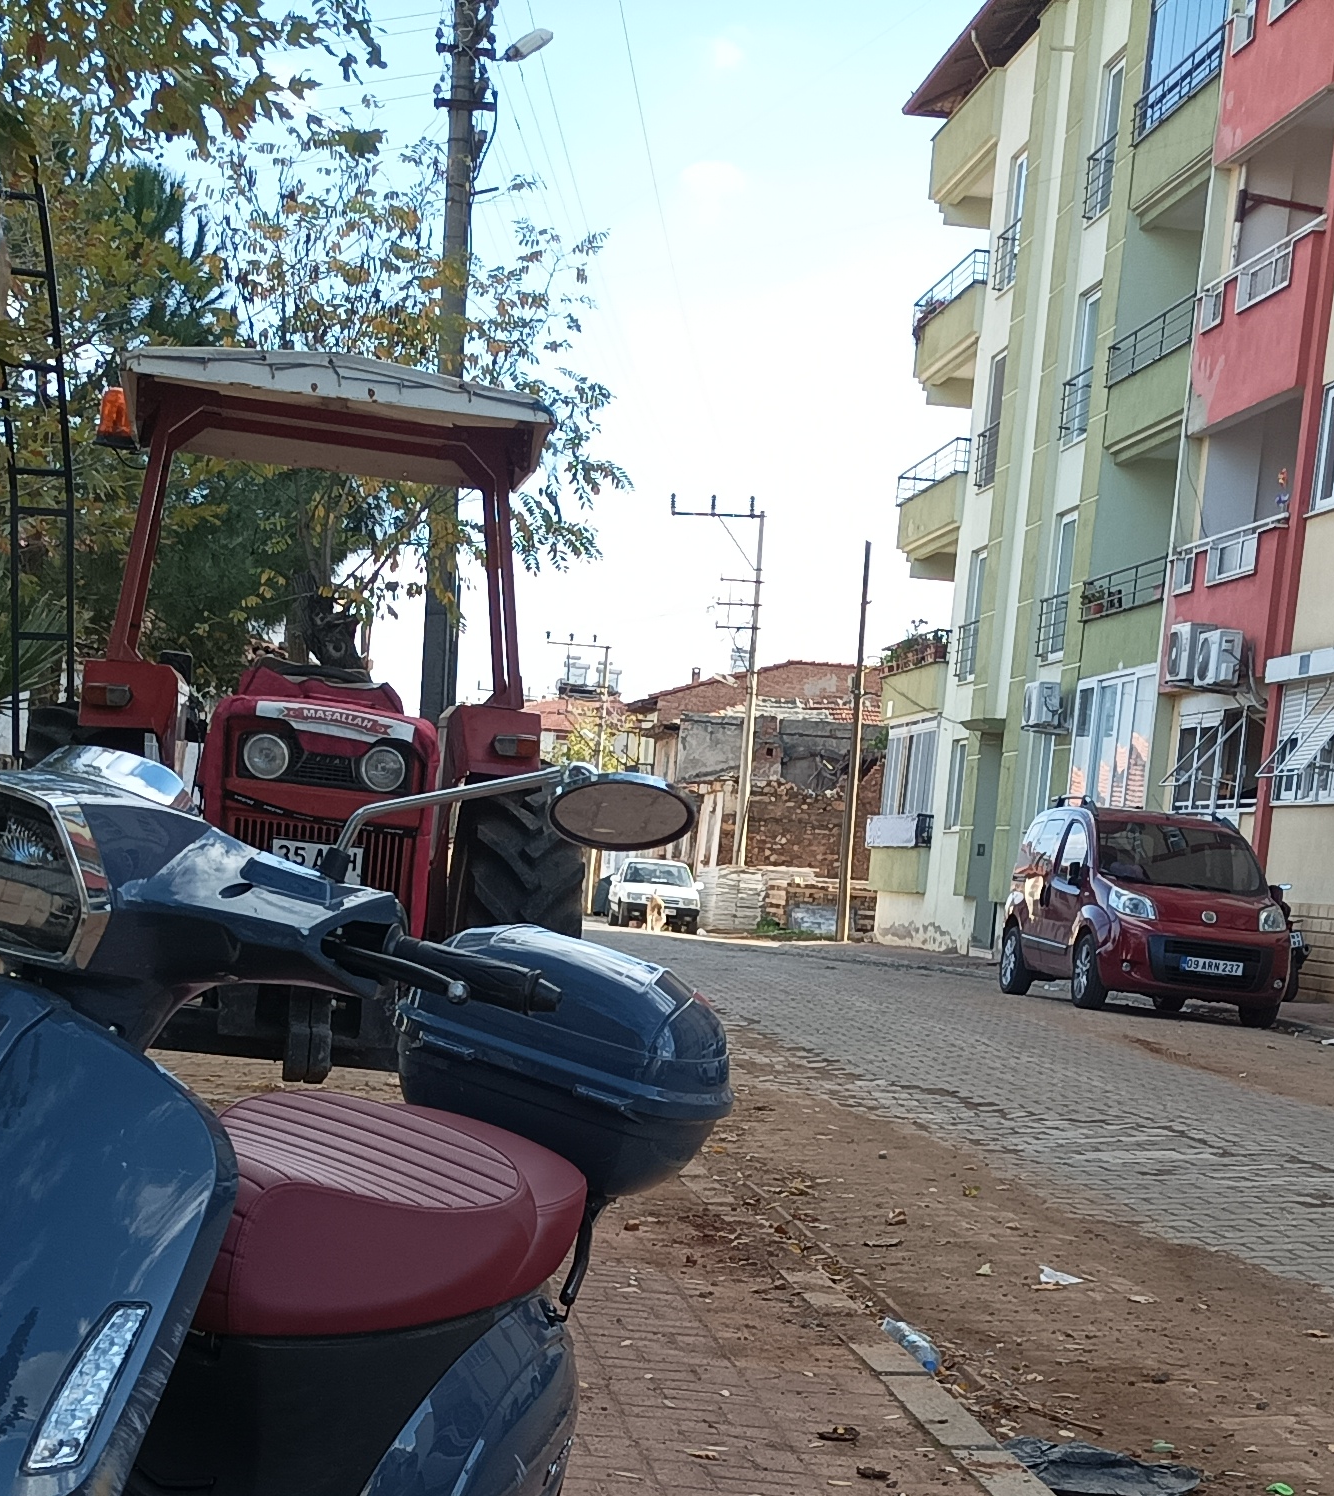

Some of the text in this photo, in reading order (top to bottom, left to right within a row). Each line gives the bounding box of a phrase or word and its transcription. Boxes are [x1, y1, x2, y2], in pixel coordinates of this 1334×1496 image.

[303, 708, 373, 730] MAŞALLAH
[278, 844, 307, 866] 35
[1186, 959, 1200, 969] 09
[1201, 960, 1221, 972] ARN
[1221, 963, 1241, 974] 237
